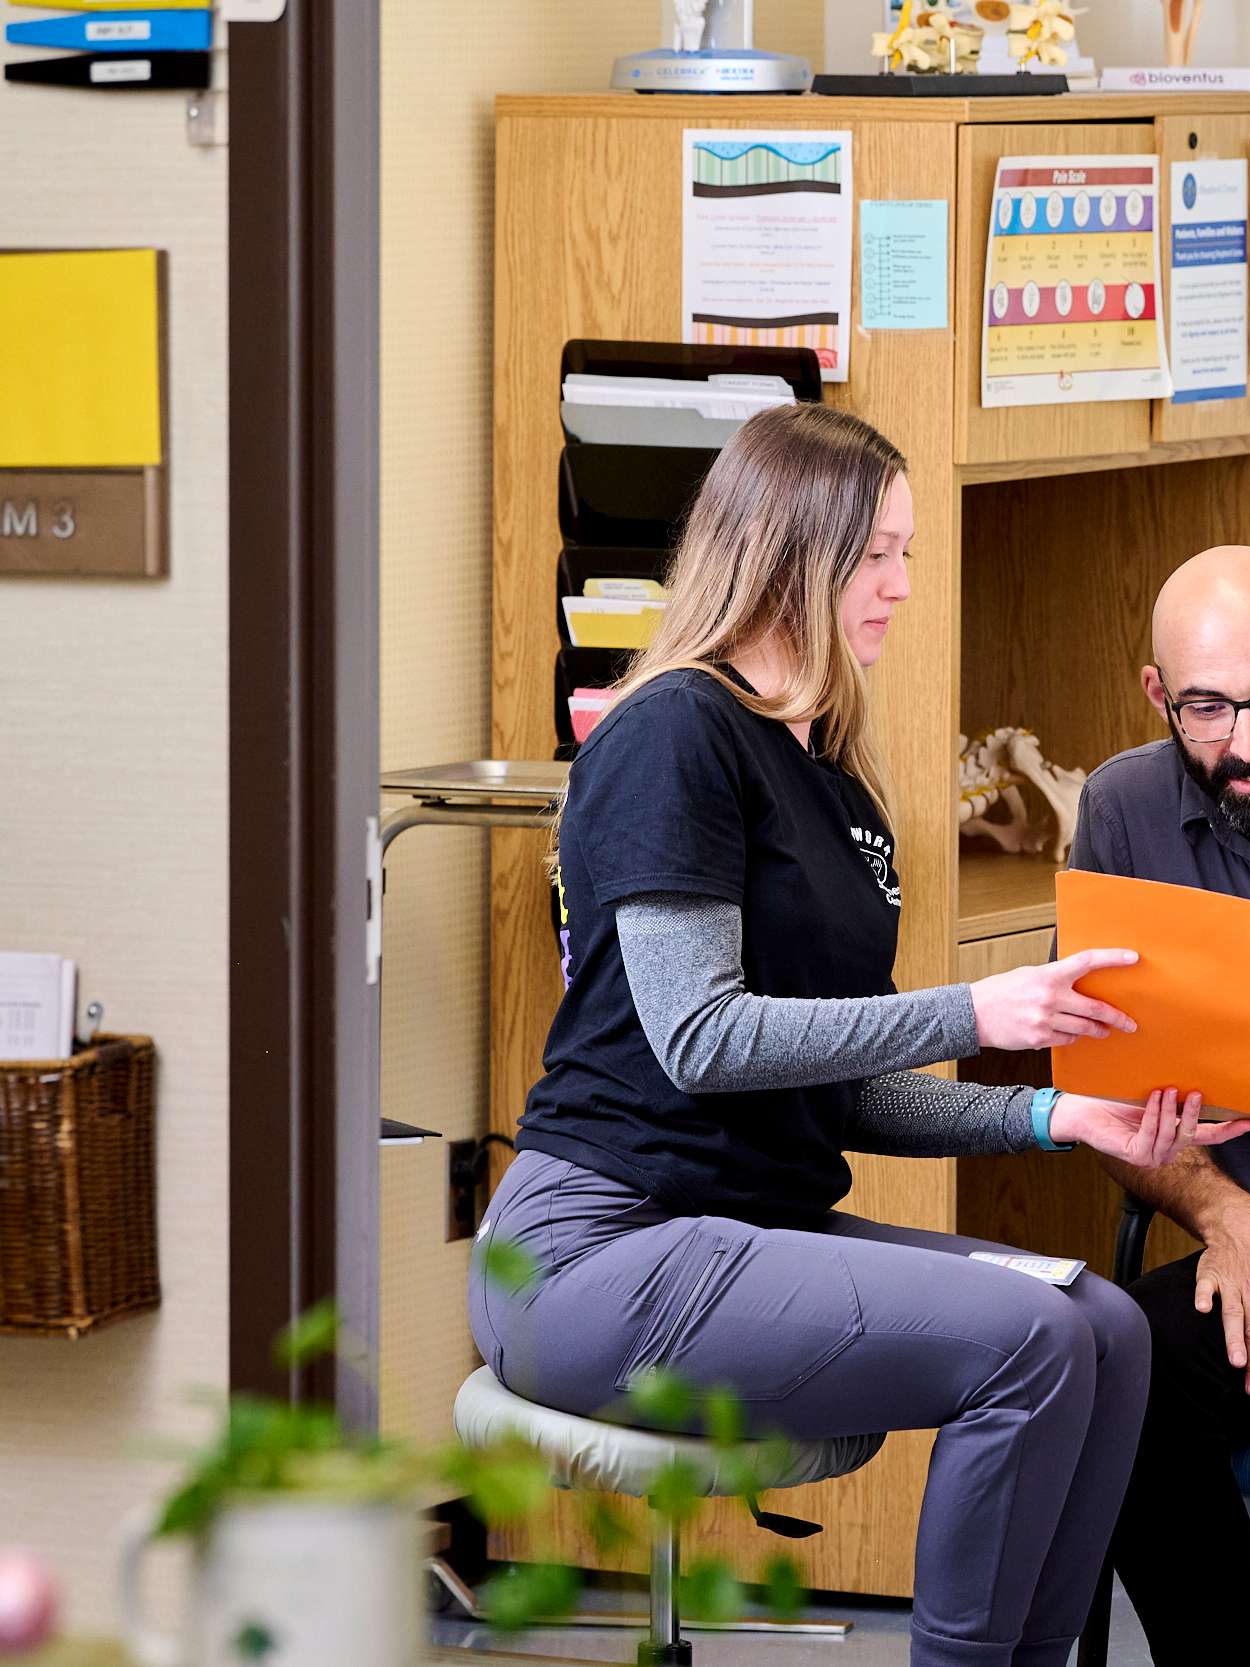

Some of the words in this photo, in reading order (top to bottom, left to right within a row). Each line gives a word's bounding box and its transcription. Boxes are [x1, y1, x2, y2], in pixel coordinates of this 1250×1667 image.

[1148, 72, 1224, 84] bioventus
[1052, 170, 1068, 185] Pain
[1068, 169, 1087, 184] Scale
[51, 502, 76, 539] 3
